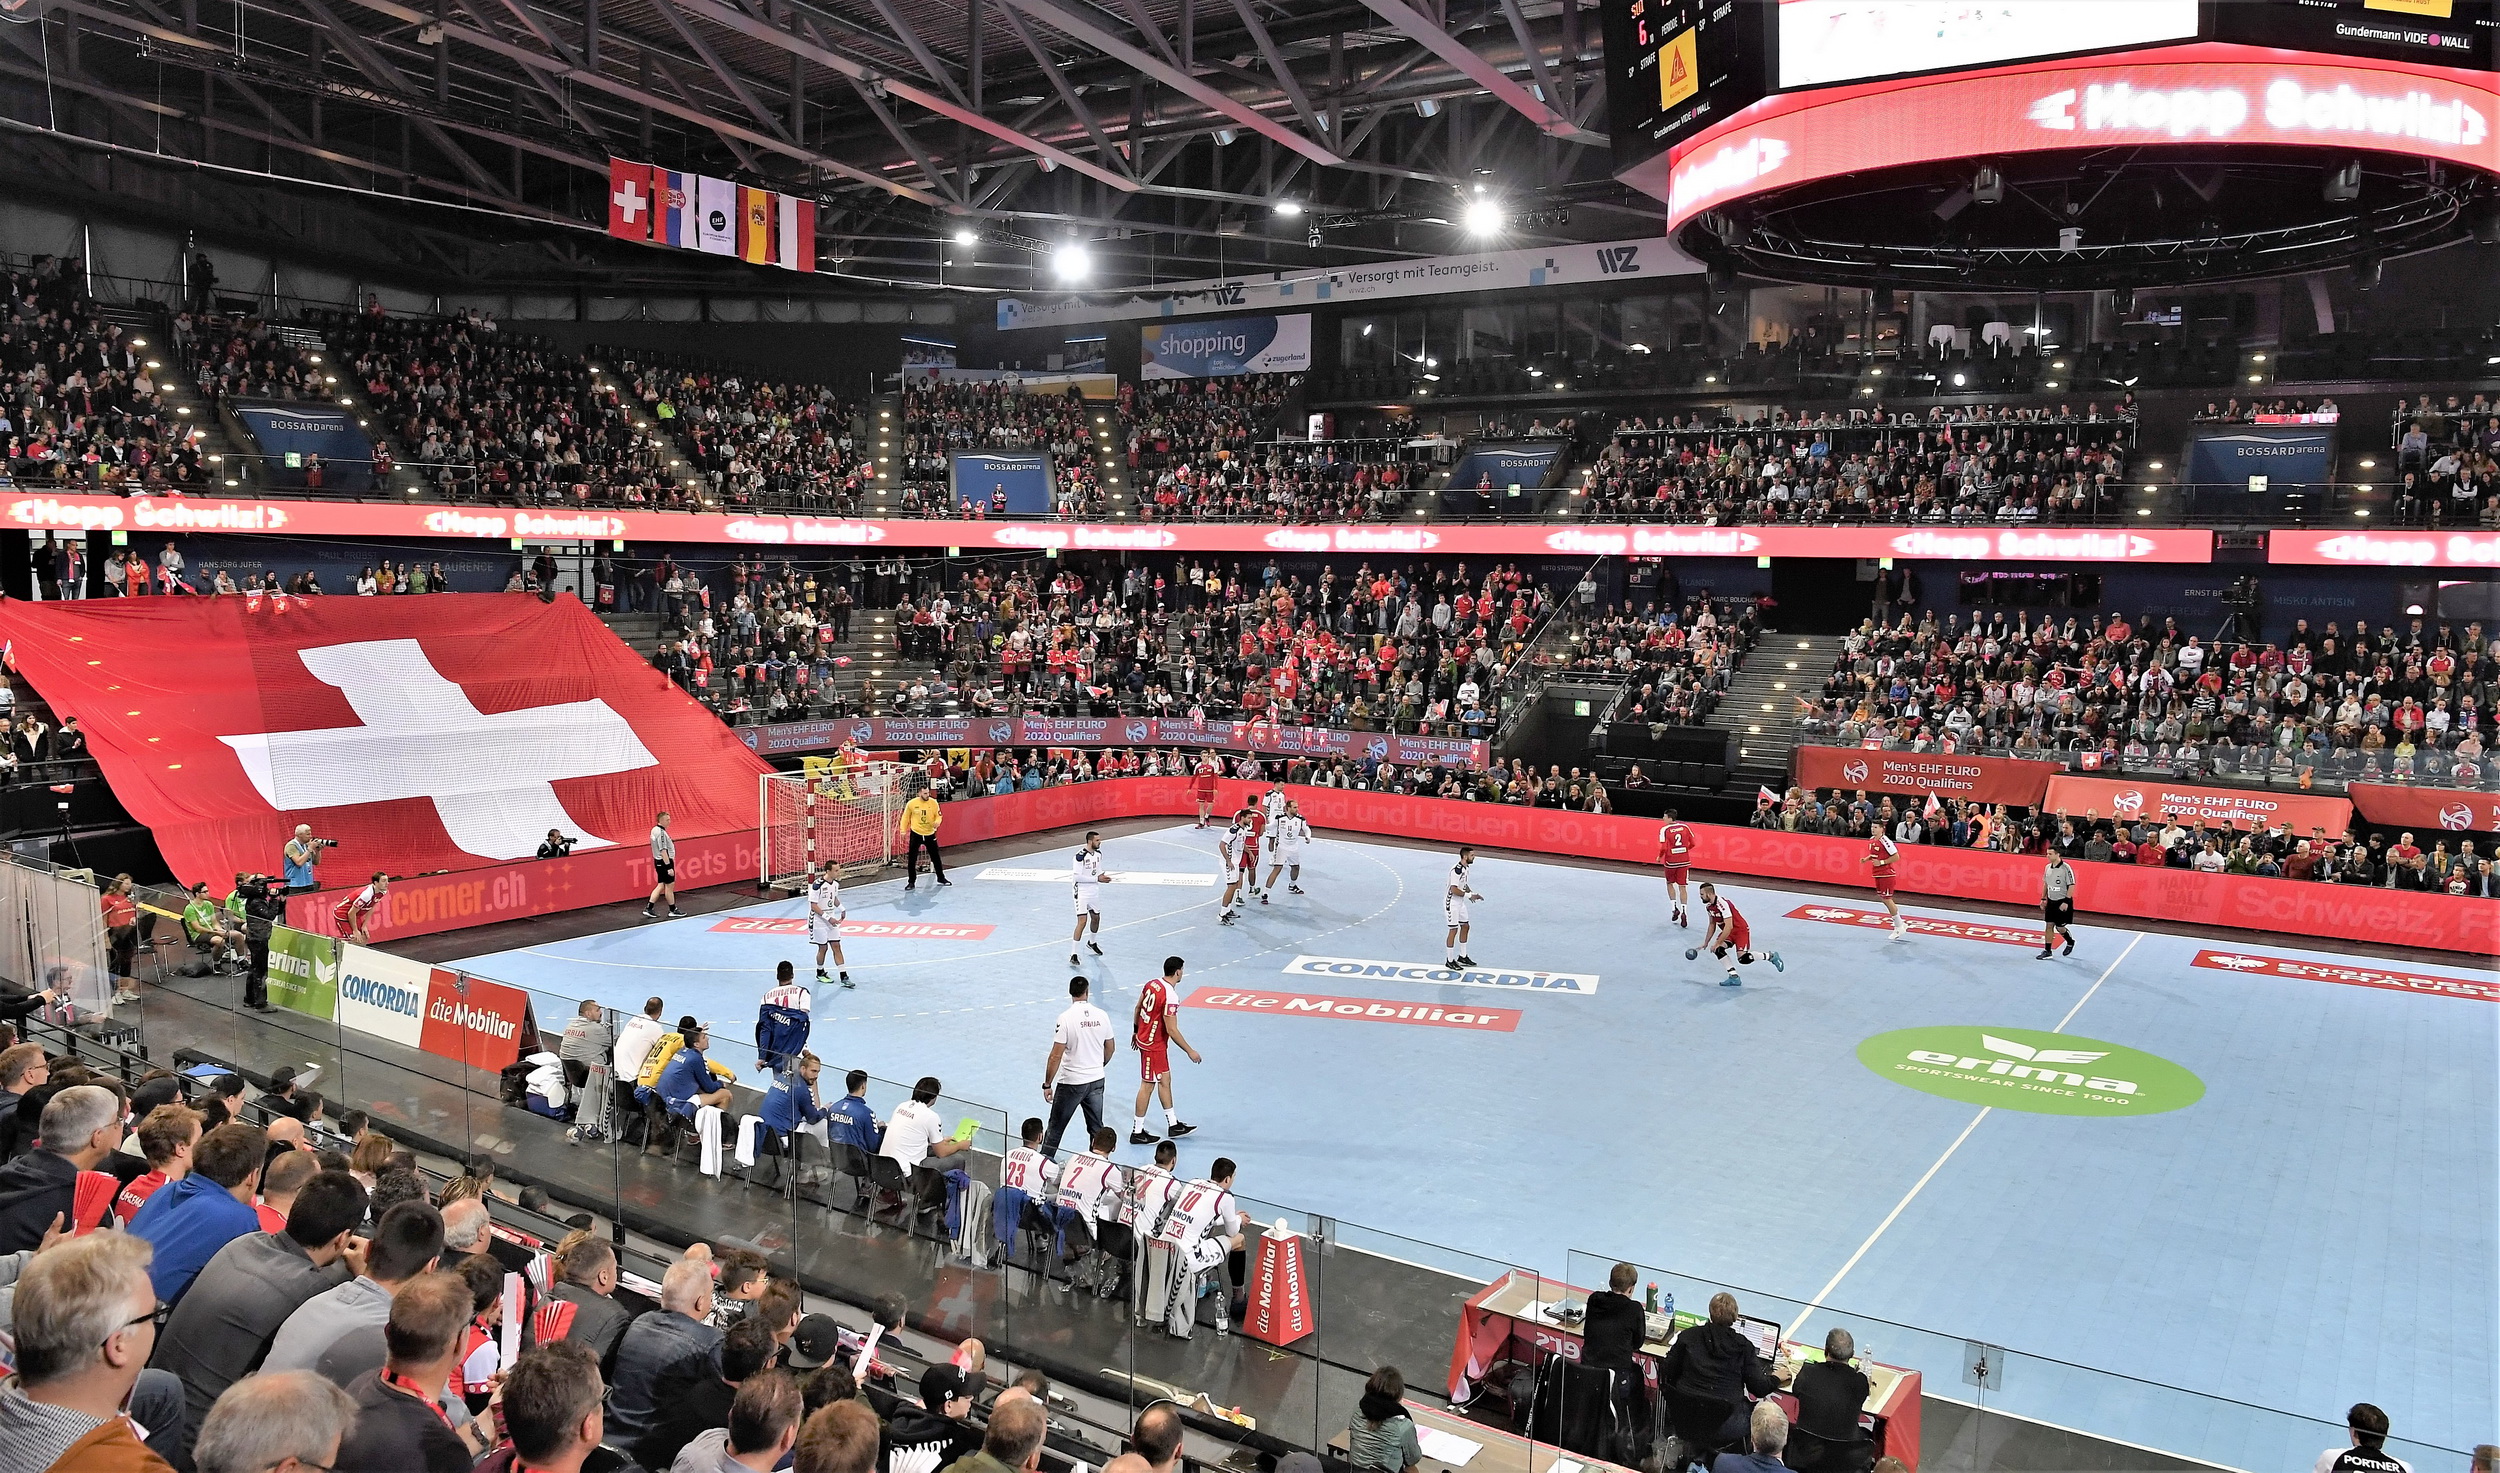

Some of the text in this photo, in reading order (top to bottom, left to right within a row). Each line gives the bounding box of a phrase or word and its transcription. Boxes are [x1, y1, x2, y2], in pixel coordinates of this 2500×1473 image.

[1713, 1, 1731, 22] STRAFE
[1639, 20, 1647, 45] 6
[2336, 24, 2401, 41] Gundermann
[2084, 83, 2248, 136] Hopp
[1348, 257, 1499, 284] Versorgt mit Teamgeist.
[1160, 331, 1247, 359] shopping
[33, 499, 123, 530] Hopp
[2184, 589, 2211, 597] ERNST
[768, 722, 835, 737] Men's EHF EURO
[885, 720, 970, 729] Men's EHF EURO
[1024, 720, 1107, 729] Men's EHF EURO
[1160, 721, 1232, 732] Men's EURO
[768, 735, 830, 749] 2020 Qualifiers
[885, 732, 964, 742] 2020 Qualifiers
[1024, 732, 1101, 742] 2020 Qualifiers
[1160, 732, 1228, 744] 2020 Qualifiers
[1278, 741, 1301, 750] 2020
[1400, 738, 1472, 752] Men's EHF EUR
[1400, 750, 1425, 760] 2020
[1883, 761, 1982, 776] Men's EHF EURO
[1882, 774, 1974, 790] 2020 Qualifiers
[2161, 793, 2279, 810] Men's EHF EURO
[1414, 805, 1520, 839] Litauen
[2160, 804, 2268, 822] 2020 Qualifiers
[1674, 833, 1682, 846] 2
[626, 848, 727, 888] Tikets
[2237, 885, 2443, 942] Schweiz,
[729, 920, 977, 937] die obiliar
[267, 949, 310, 980] erima
[1301, 961, 1592, 991] CONCORDIA
[342, 974, 419, 1019] CONCORDIA
[1142, 988, 1156, 1013] 20
[1203, 992, 1501, 1025] die Mobiliar
[430, 996, 517, 1041] die Mobiliar
[1080, 1020, 1102, 1029] SRBIJA
[1906, 1049, 2139, 1096] erima
[1893, 1062, 2129, 1106] SPORTSWEAR SINCE 1900
[829, 1111, 854, 1126] SRBIJA
[1006, 1161, 1026, 1188] 23
[1067, 1166, 1084, 1189] 2
[1178, 1190, 1203, 1213] 10
[1256, 1240, 1277, 1334] die Mobiliar
[1286, 1241, 1303, 1332] die Mobiliar
[2343, 1455, 2401, 1473] PORTNER
